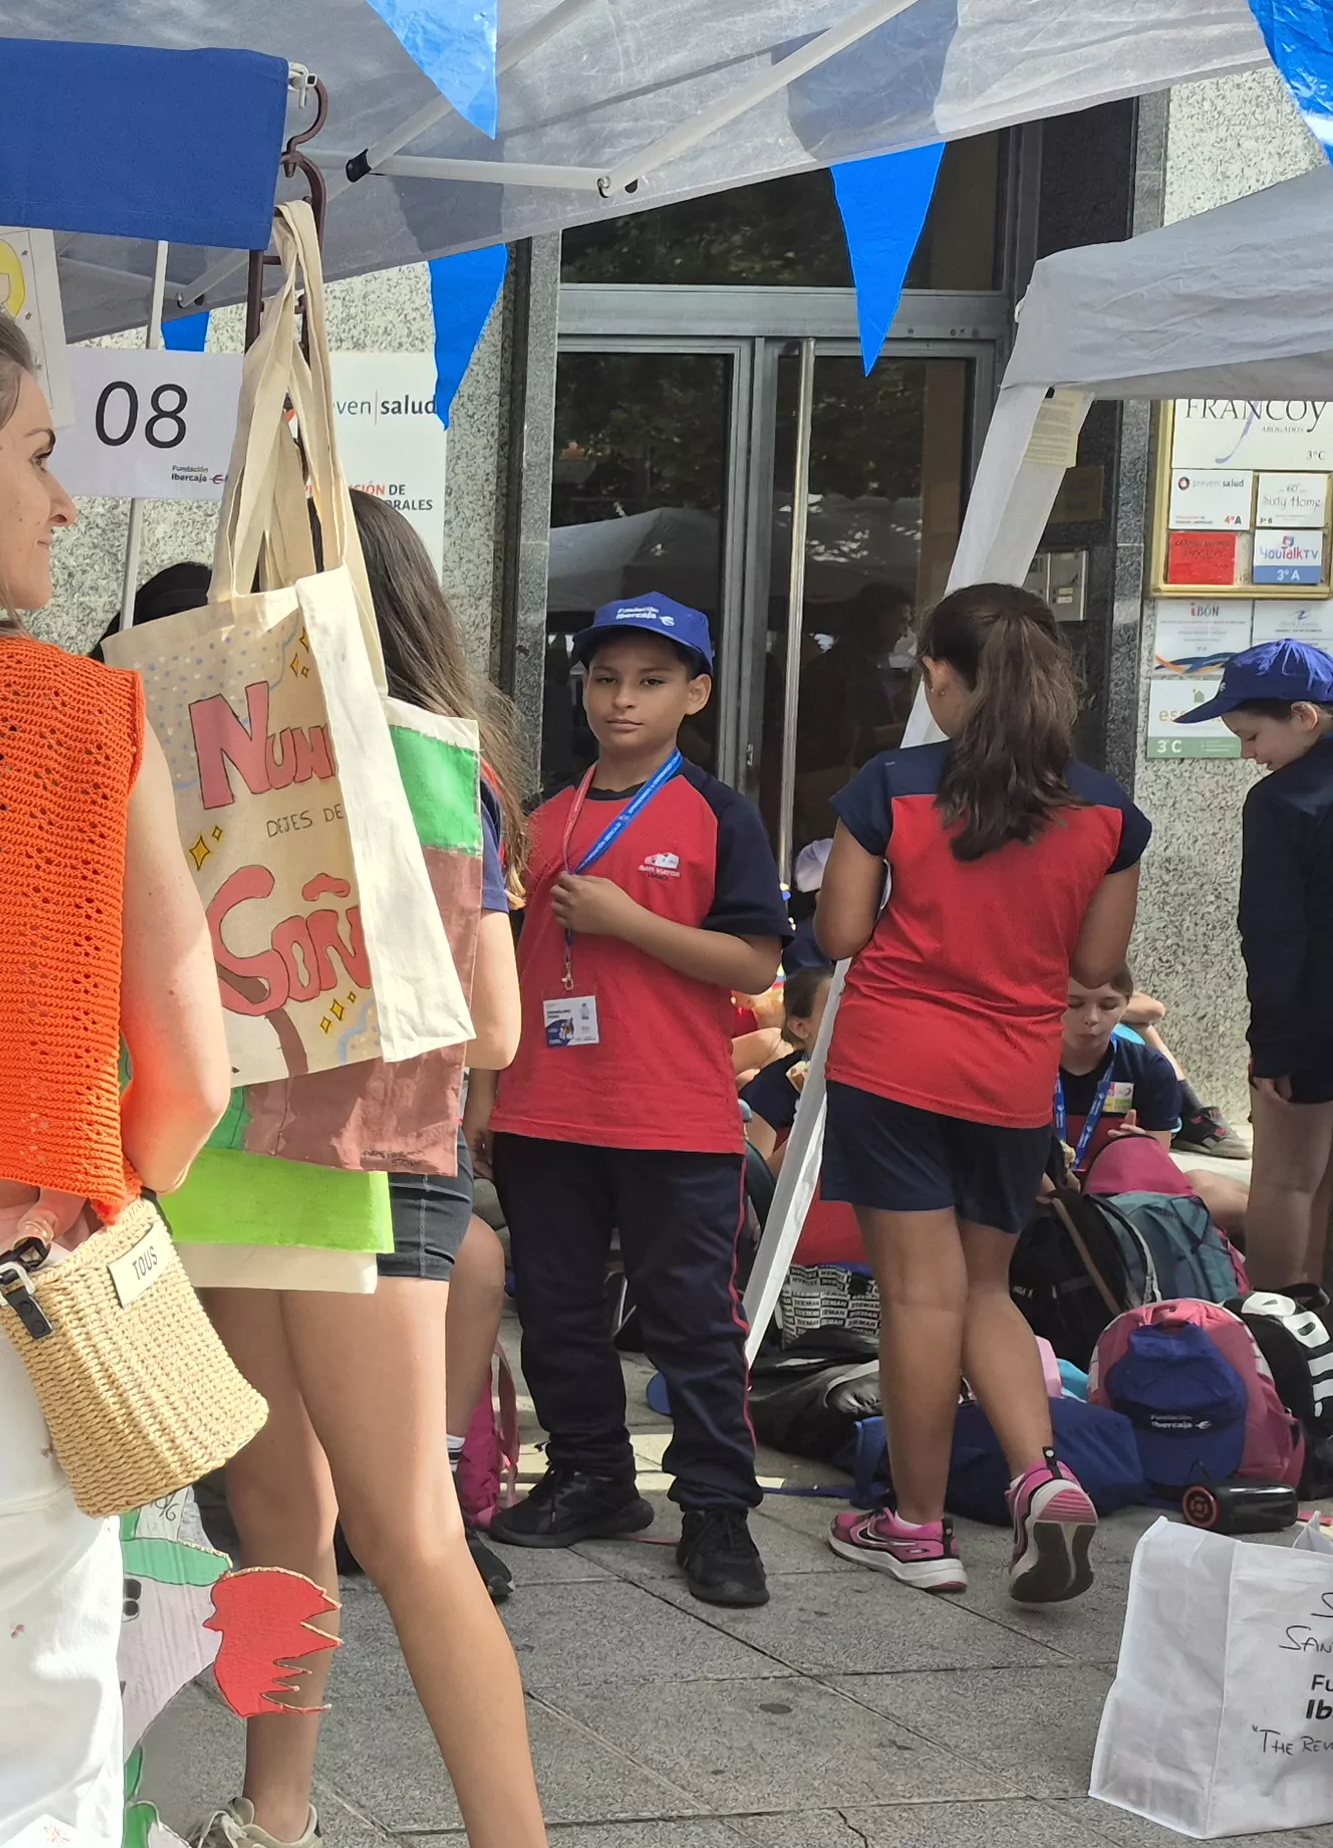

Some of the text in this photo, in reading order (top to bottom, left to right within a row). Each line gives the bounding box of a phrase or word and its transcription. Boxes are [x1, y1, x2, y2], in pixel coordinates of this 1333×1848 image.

[95, 380, 189, 449] 08
[171, 472, 208, 484] Ibercaja
[388, 484, 406, 495] DE
[1222, 478, 1244, 488] salud
[265, 803, 344, 839] DEJES DE
[131, 1244, 159, 1281] TOUS
